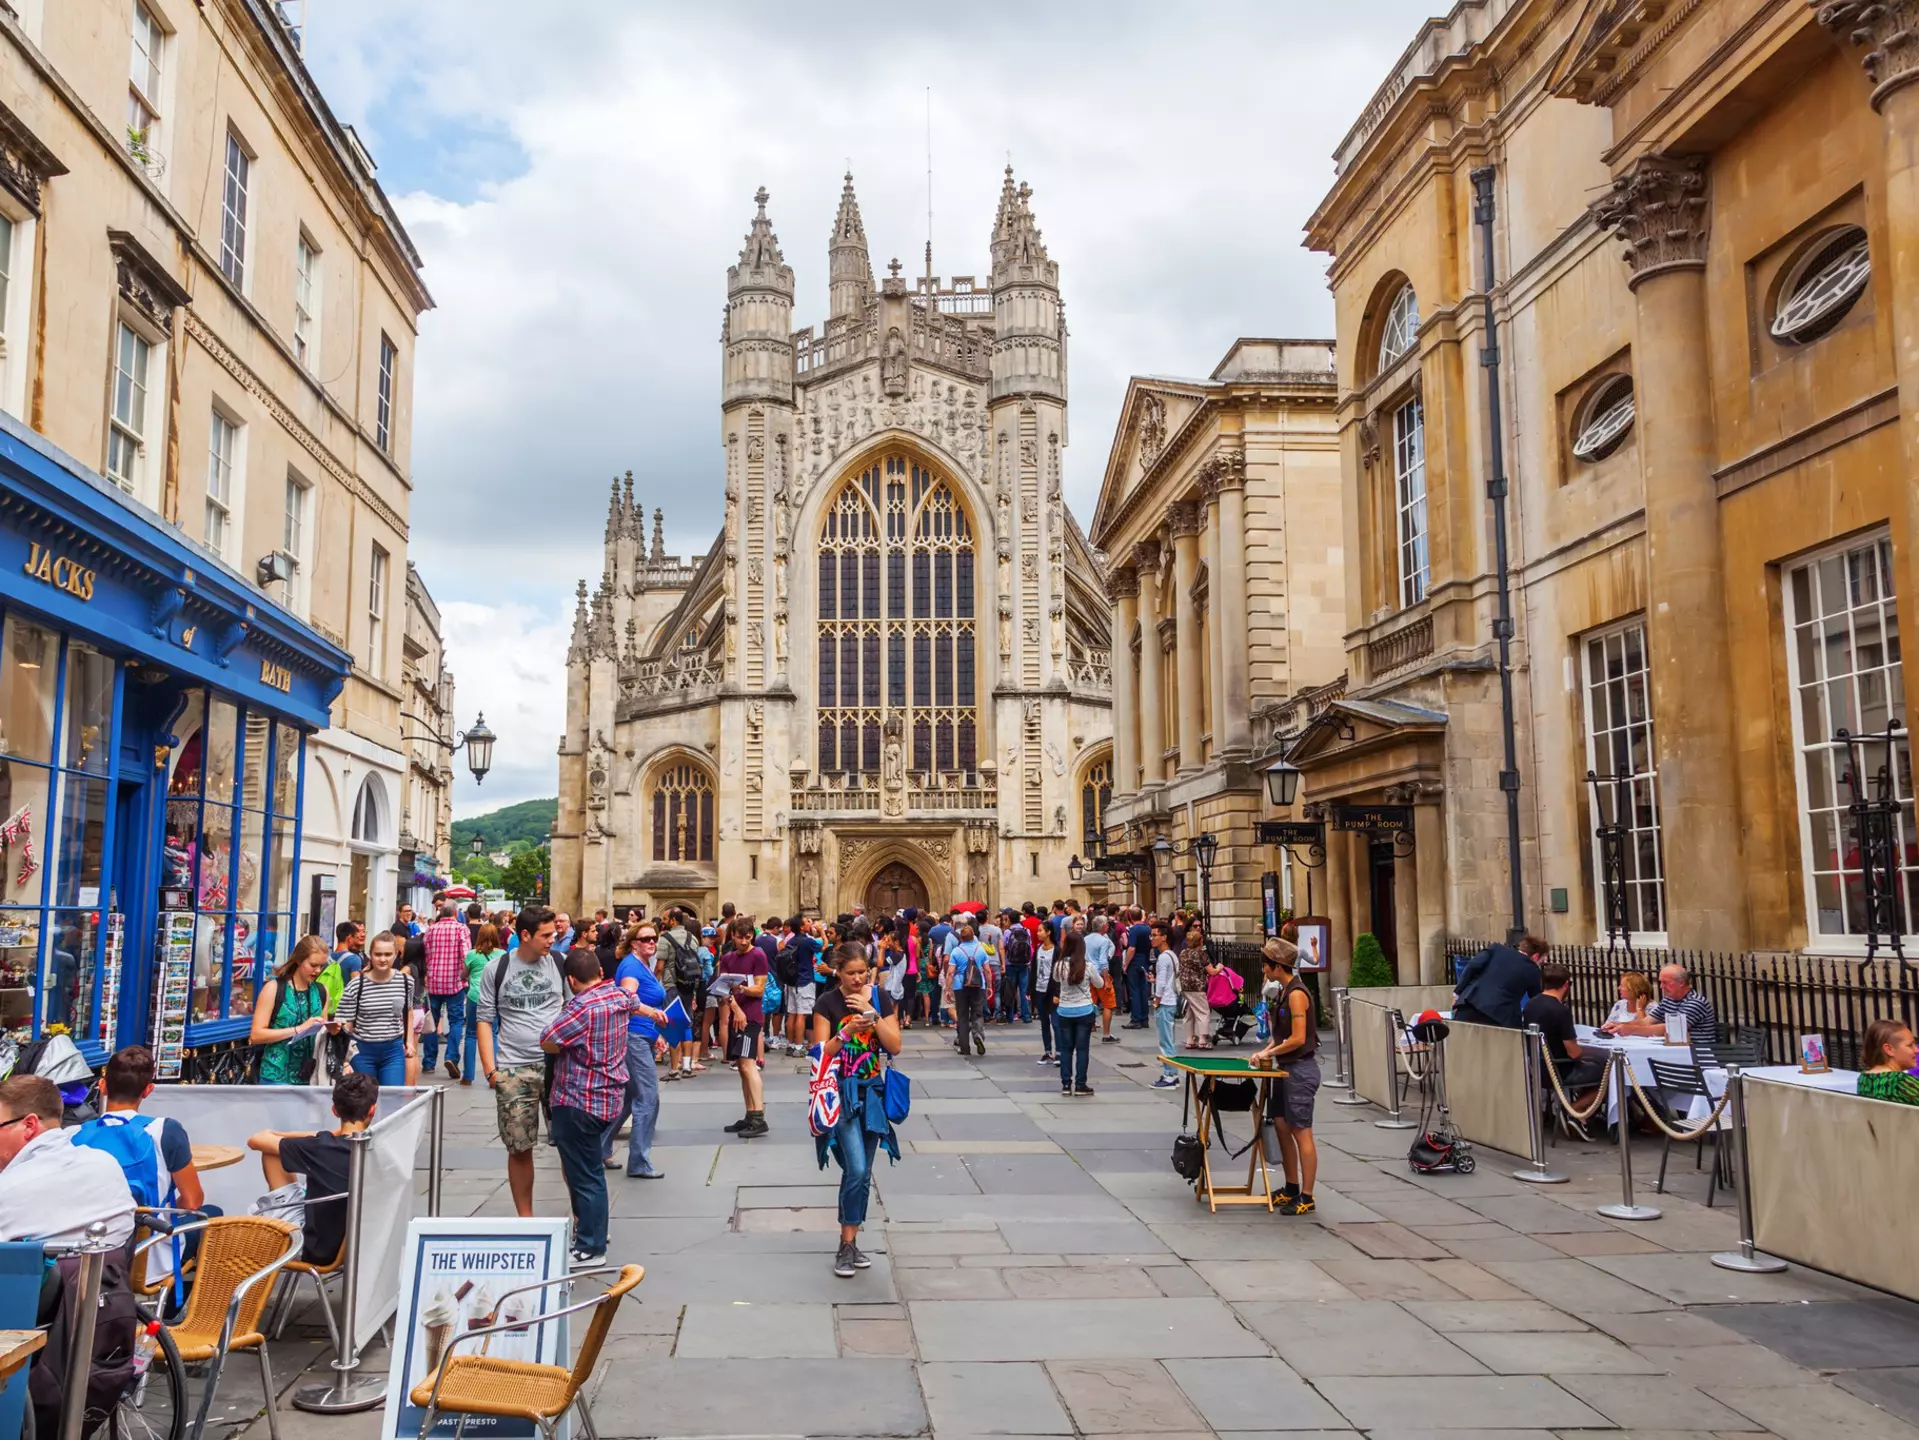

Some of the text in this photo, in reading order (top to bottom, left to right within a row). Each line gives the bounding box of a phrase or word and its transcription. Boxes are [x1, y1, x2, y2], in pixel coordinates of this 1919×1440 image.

[24, 541, 291, 692] JACKS of BATH
[1364, 813, 1383, 821] THE
[431, 1252, 536, 1270] THE WHIPSTER
[465, 1418, 497, 1426] PRESTO
